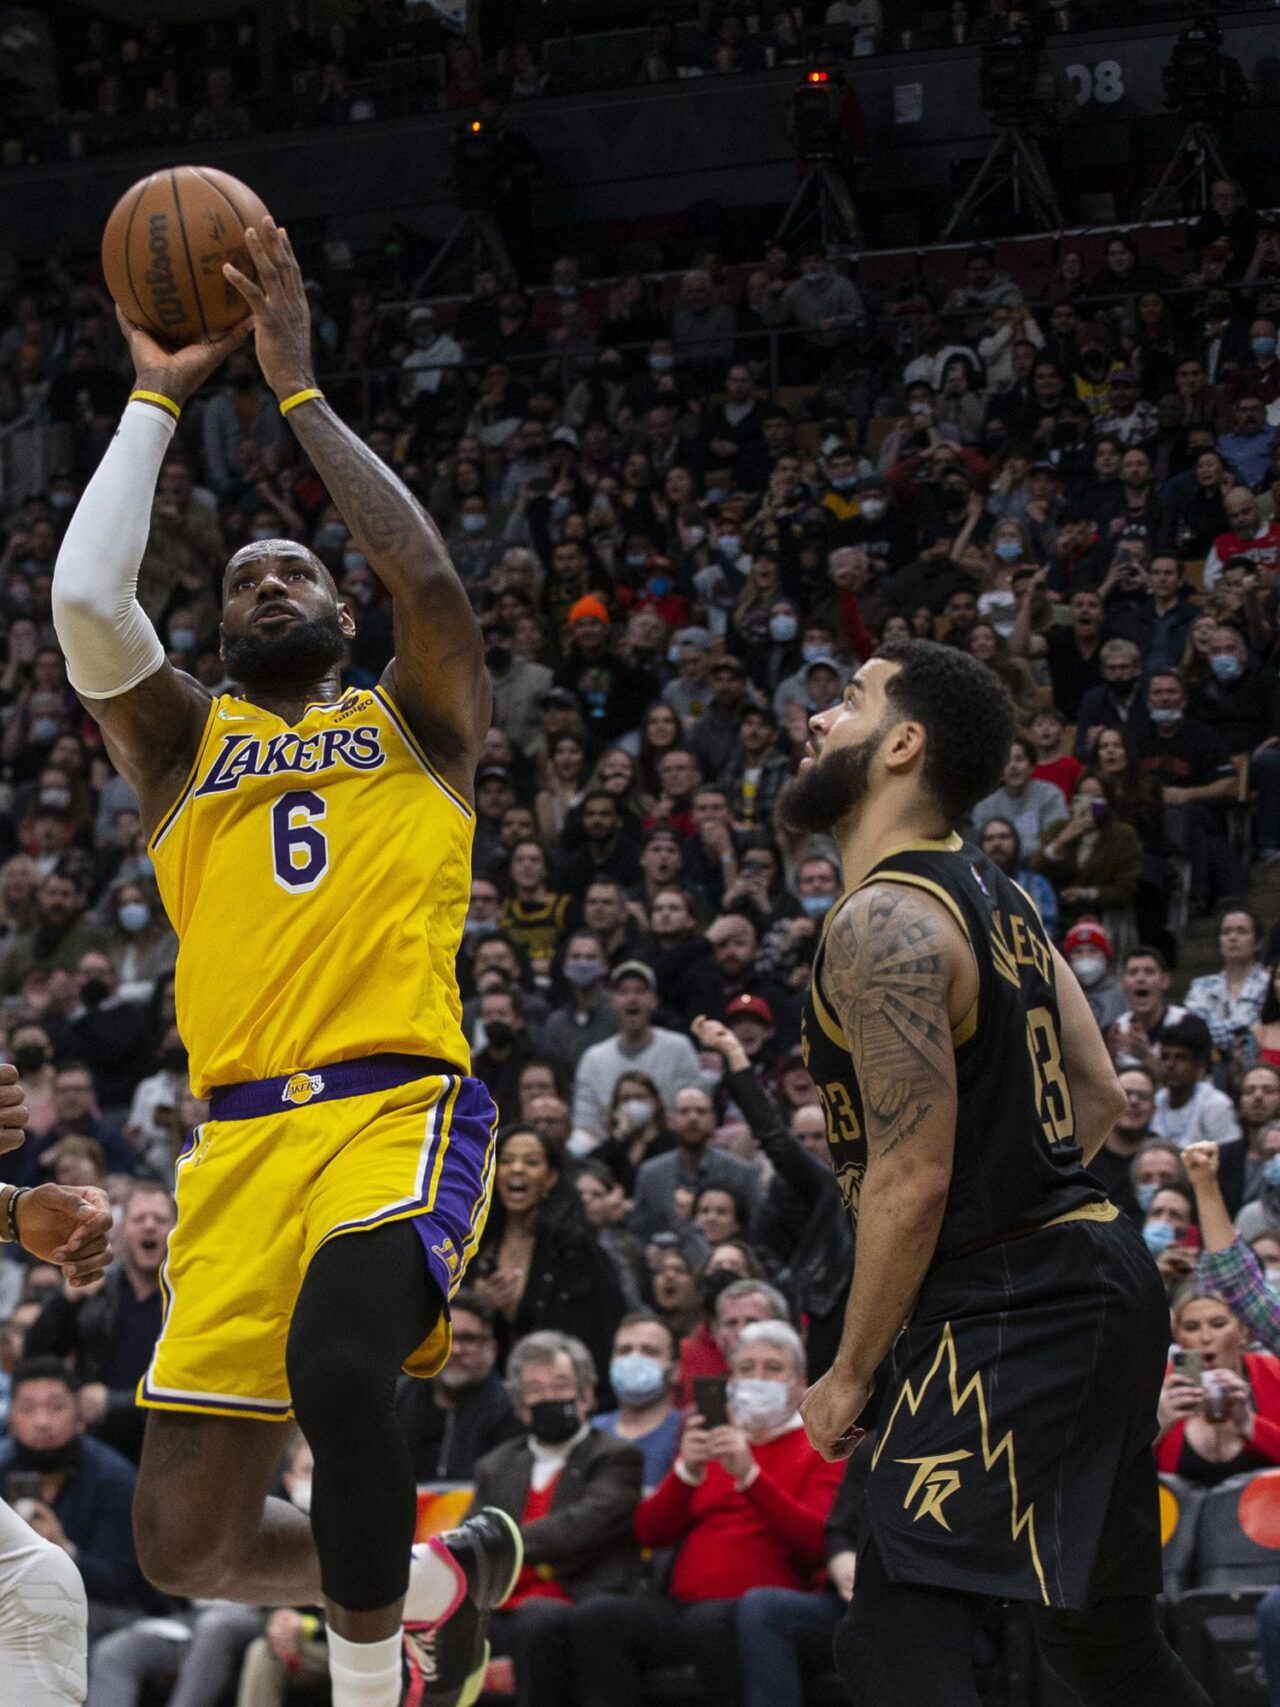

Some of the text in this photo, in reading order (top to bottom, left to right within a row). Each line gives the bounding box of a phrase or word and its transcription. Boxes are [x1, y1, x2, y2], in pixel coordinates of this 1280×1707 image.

[144, 213, 188, 326] Wilson
[333, 699, 374, 724] bibigo
[194, 726, 387, 799] LAKERS
[272, 789, 329, 894] 6
[816, 1082, 861, 1144] 23
